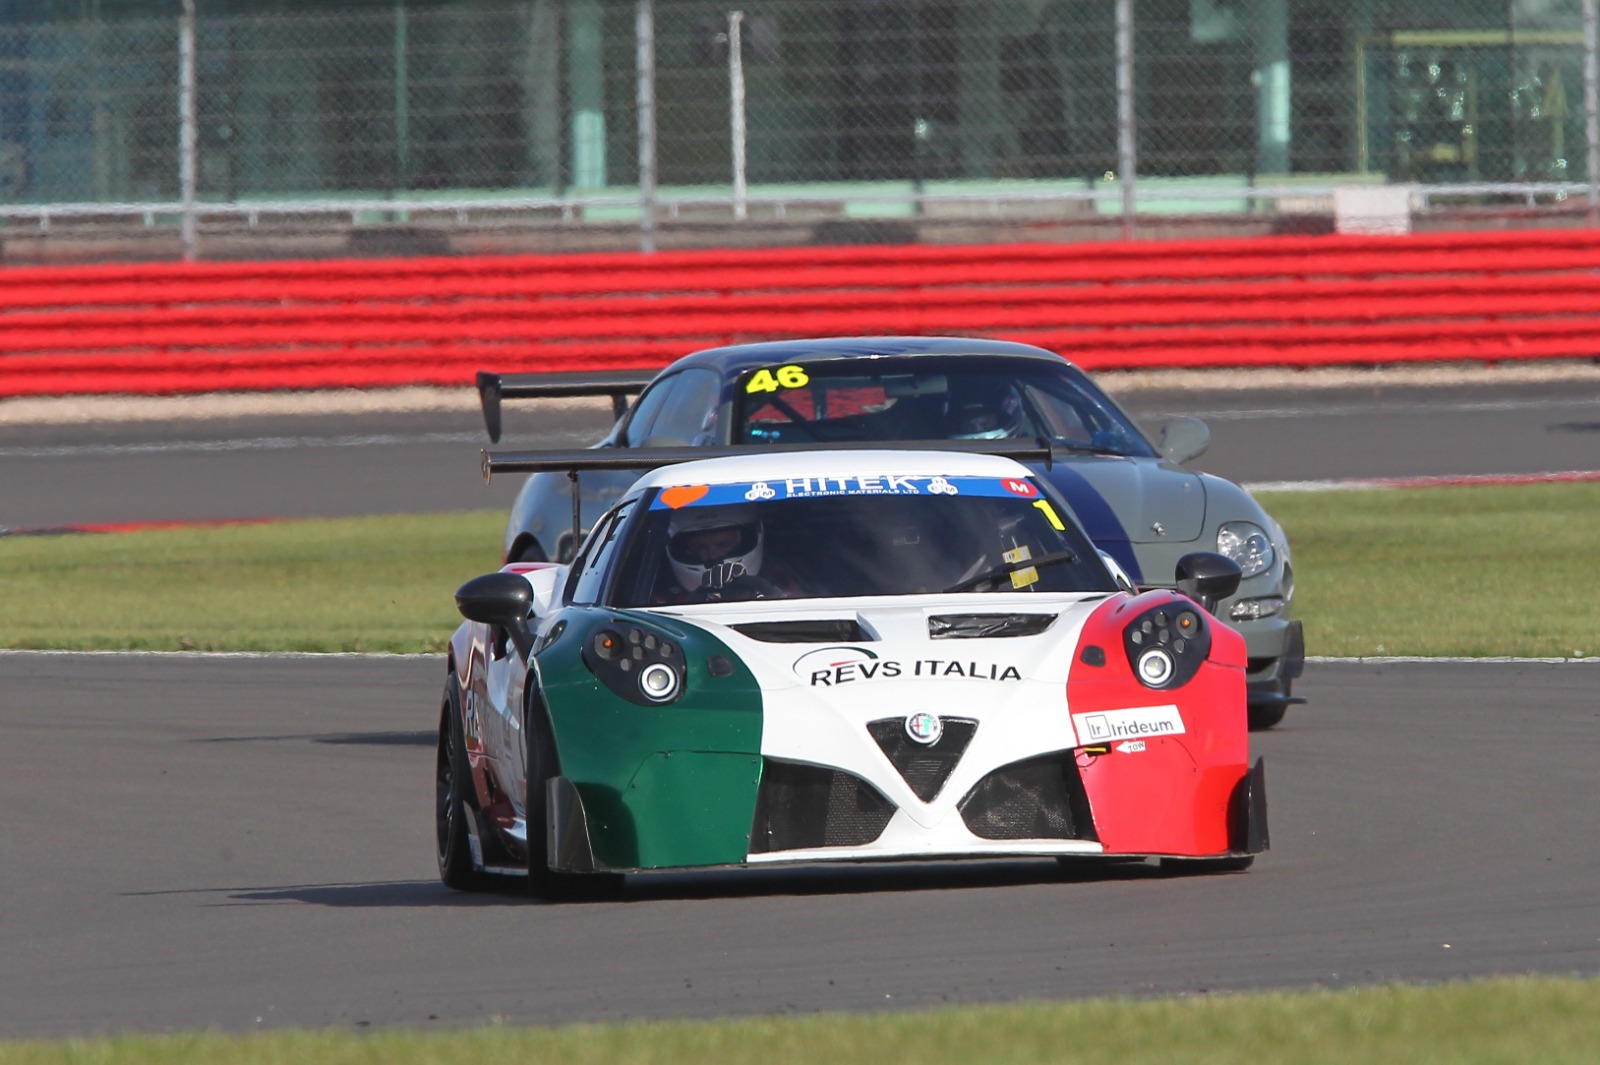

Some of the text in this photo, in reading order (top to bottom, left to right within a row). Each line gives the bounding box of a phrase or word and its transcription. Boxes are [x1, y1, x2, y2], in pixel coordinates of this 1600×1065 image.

[746, 365, 809, 394] 46
[785, 476, 918, 493] HITEK
[1009, 481, 1029, 493] M
[786, 490, 845, 498] ELECTRONIC
[1032, 499, 1066, 531] 1
[810, 660, 1022, 686] REVS ITALIA
[1111, 720, 1174, 736] Irideum
[1127, 743, 1145, 753] TOW
